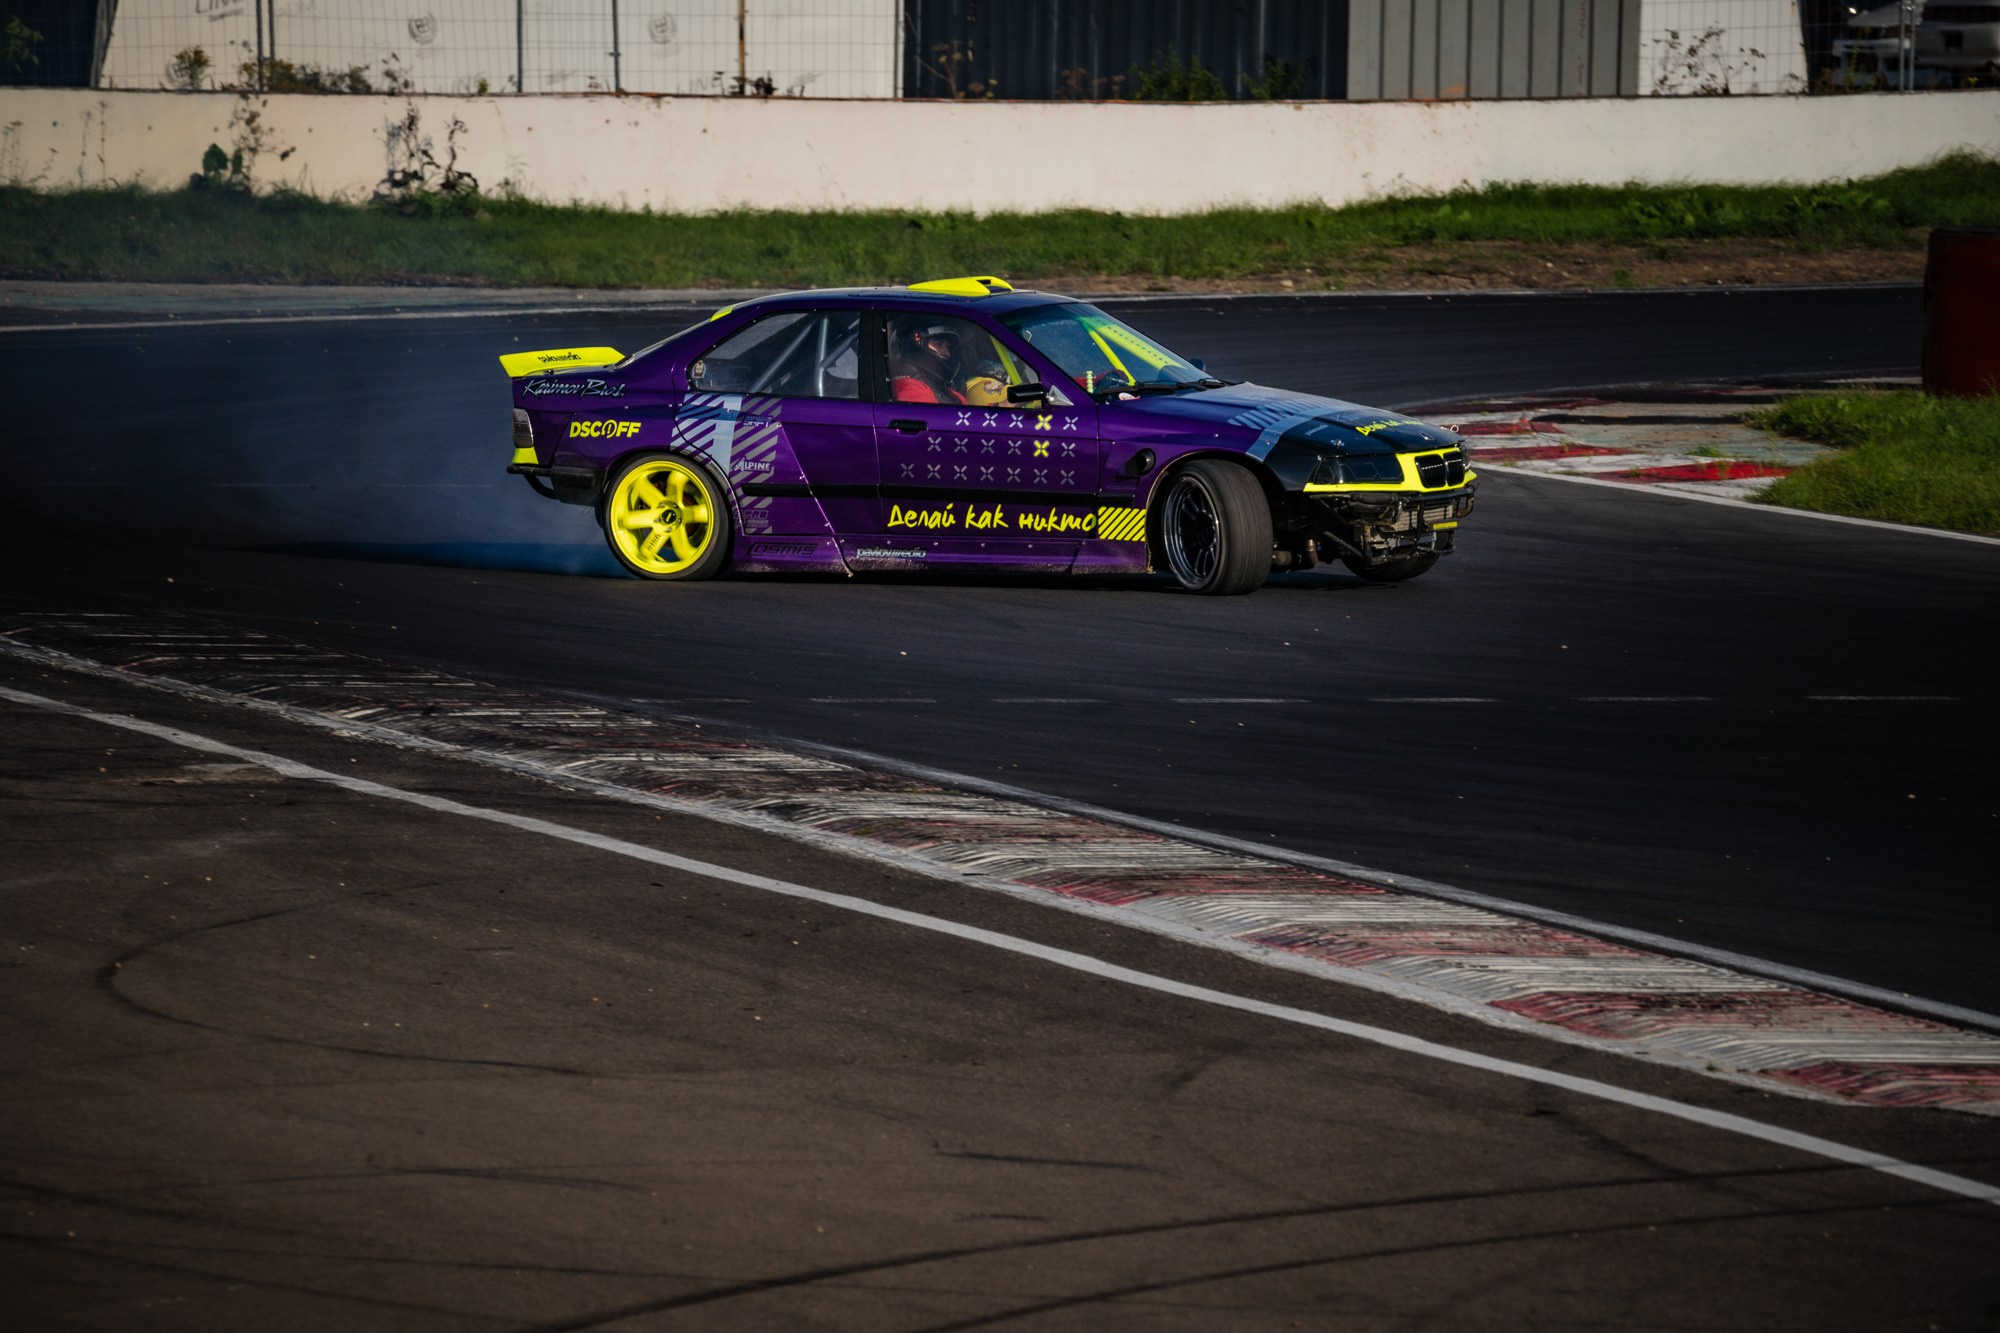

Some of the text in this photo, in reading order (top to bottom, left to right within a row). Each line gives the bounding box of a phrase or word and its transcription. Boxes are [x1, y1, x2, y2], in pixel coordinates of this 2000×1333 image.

[522, 379, 585, 398] Karimov
[887, 502, 1097, 532] Делай как никто
